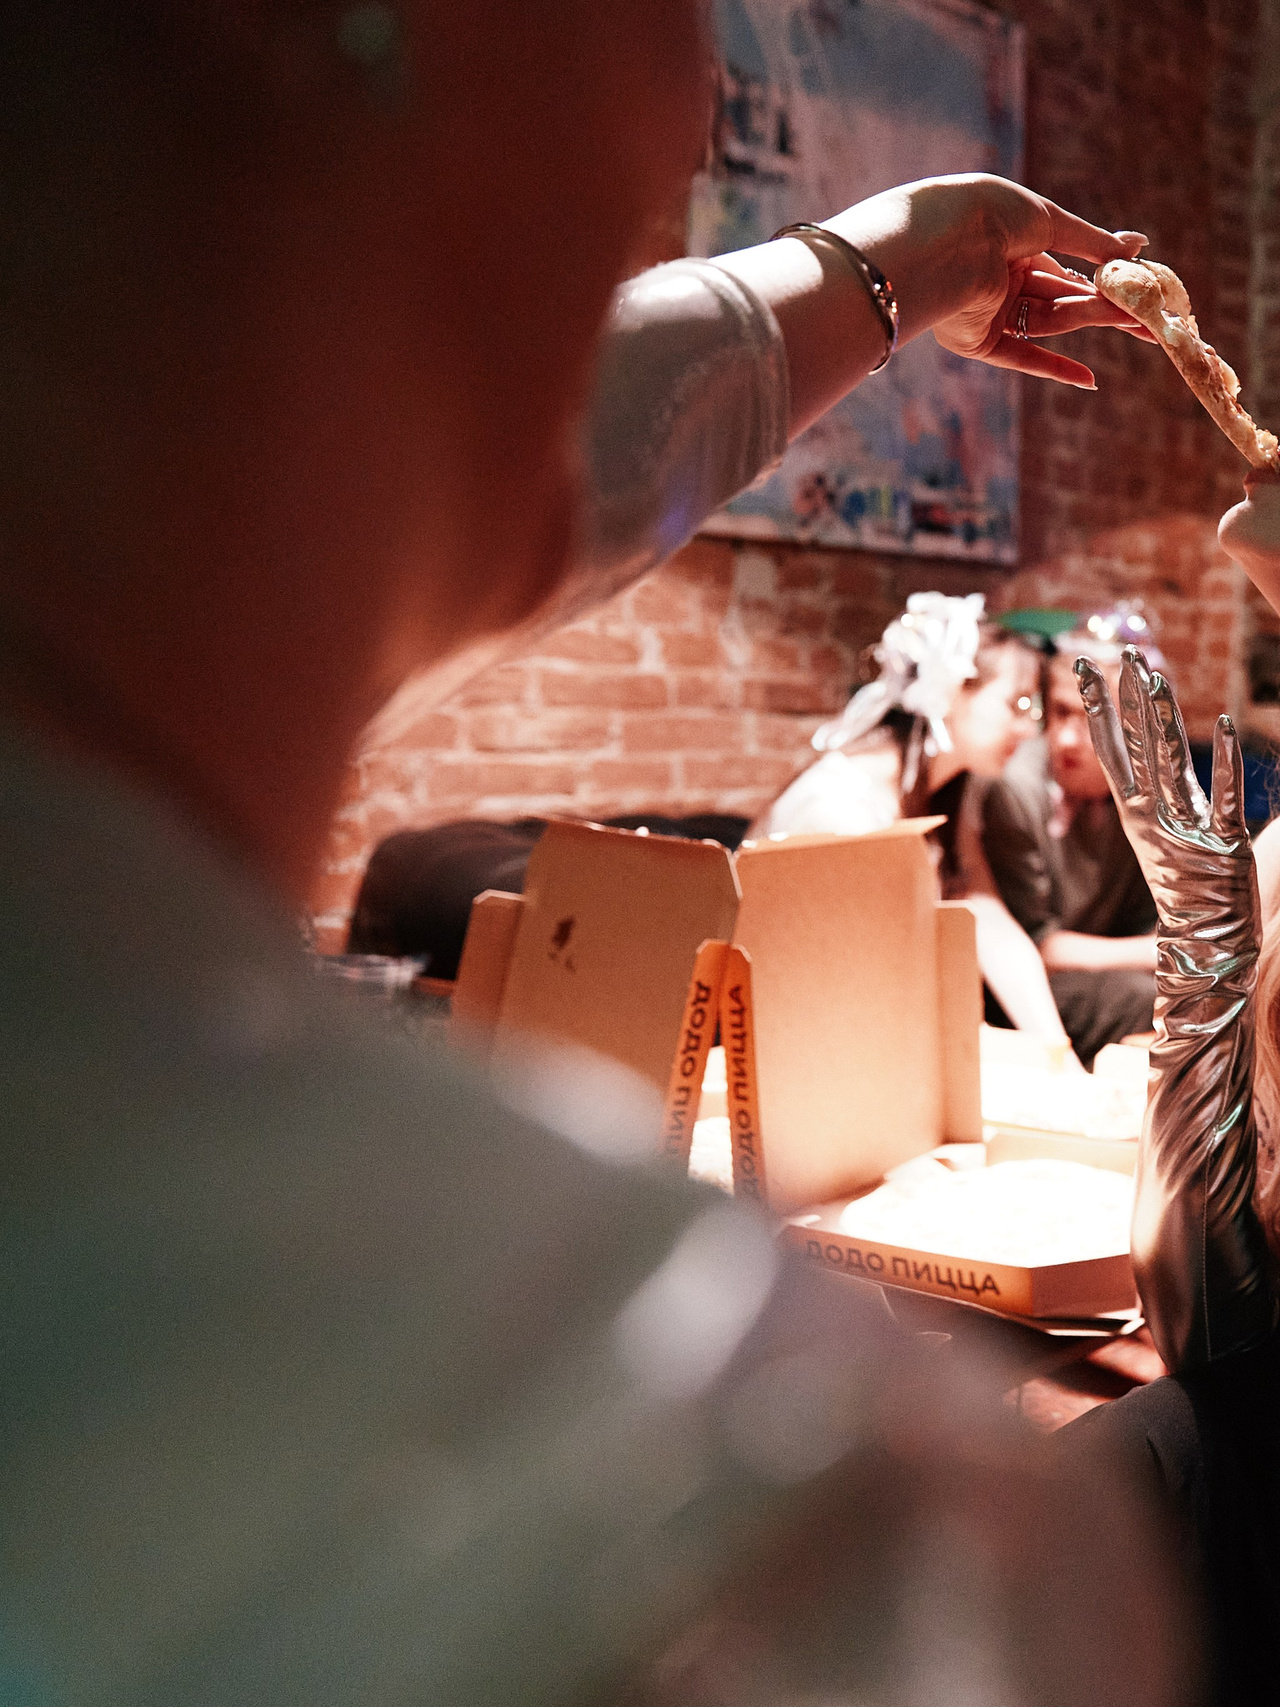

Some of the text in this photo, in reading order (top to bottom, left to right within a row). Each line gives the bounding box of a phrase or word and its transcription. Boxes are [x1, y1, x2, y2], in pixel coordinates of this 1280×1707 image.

[665, 981, 712, 1155] ДОДО ПИЦ
[728, 985, 749, 1103] ПИЦЦА
[806, 1239, 1001, 1296] ДОДО ПИЦЦА
